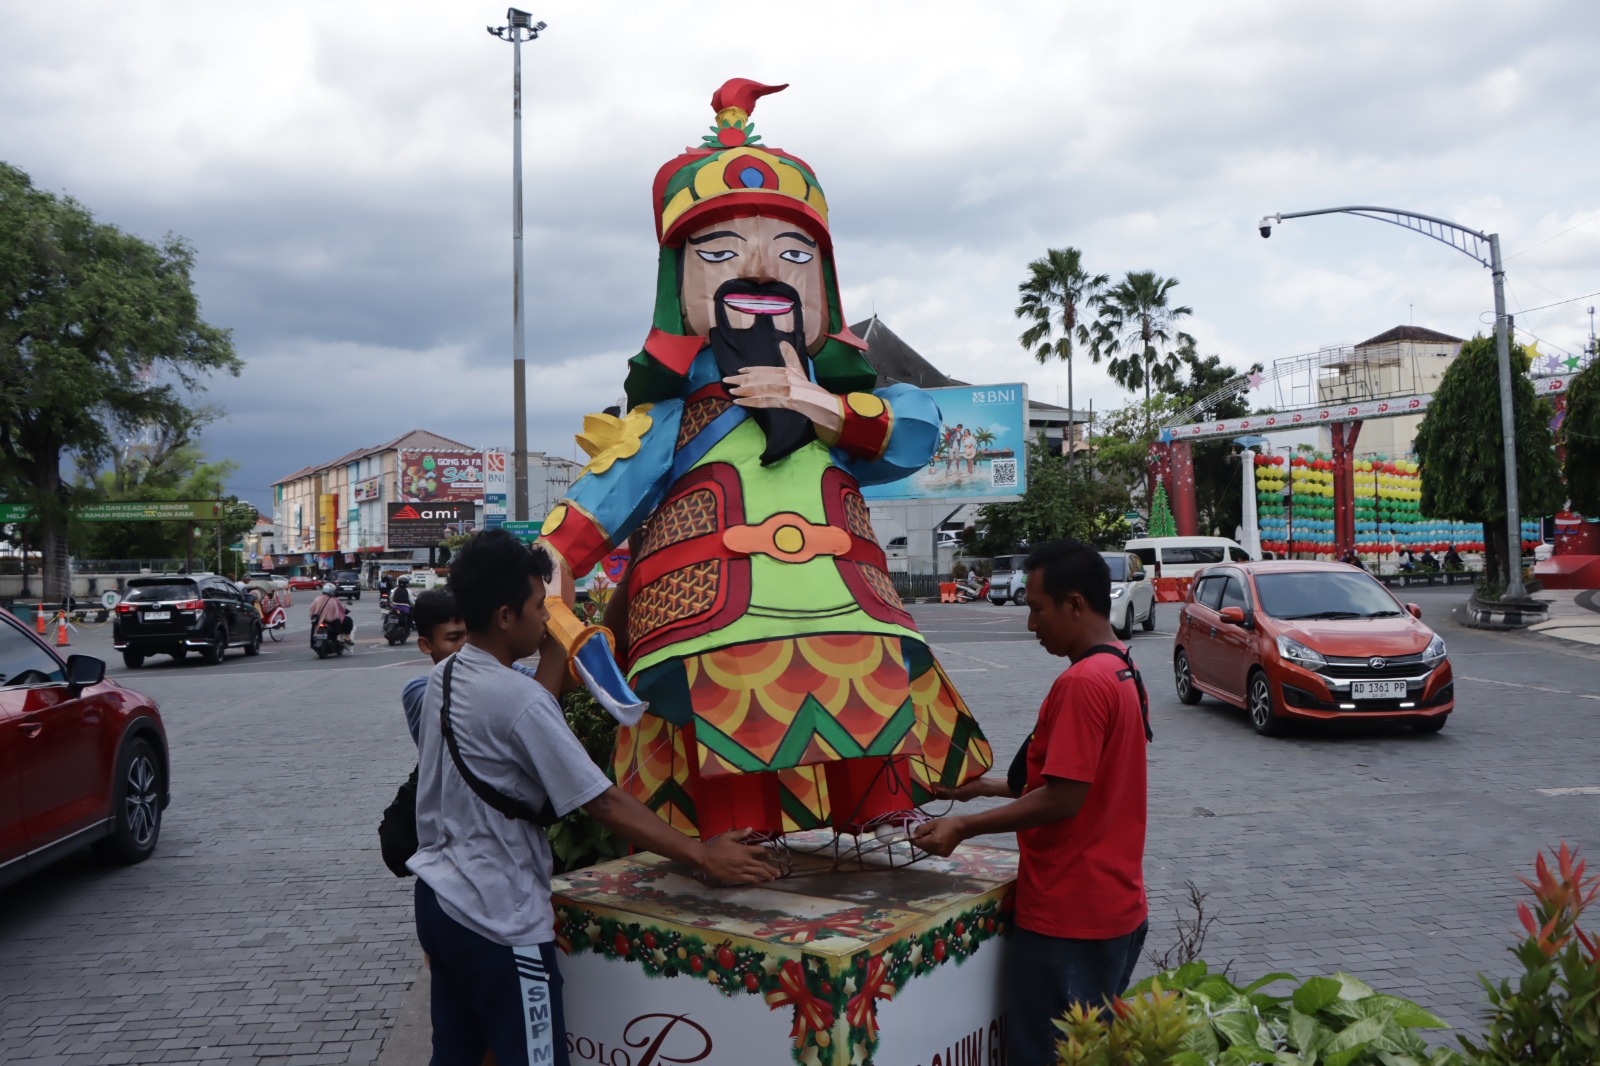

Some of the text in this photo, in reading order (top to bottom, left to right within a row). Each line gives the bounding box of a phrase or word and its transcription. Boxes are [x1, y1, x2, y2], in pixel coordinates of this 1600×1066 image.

[988, 390, 1015, 403] BNI
[437, 458, 482, 466] GONG XI FA
[488, 474, 504, 482] BNI
[421, 507, 458, 519] ami
[1354, 682, 1405, 693] AD 1361 PP
[527, 985, 552, 1066] SMP M
[565, 1031, 631, 1066] SOLO
